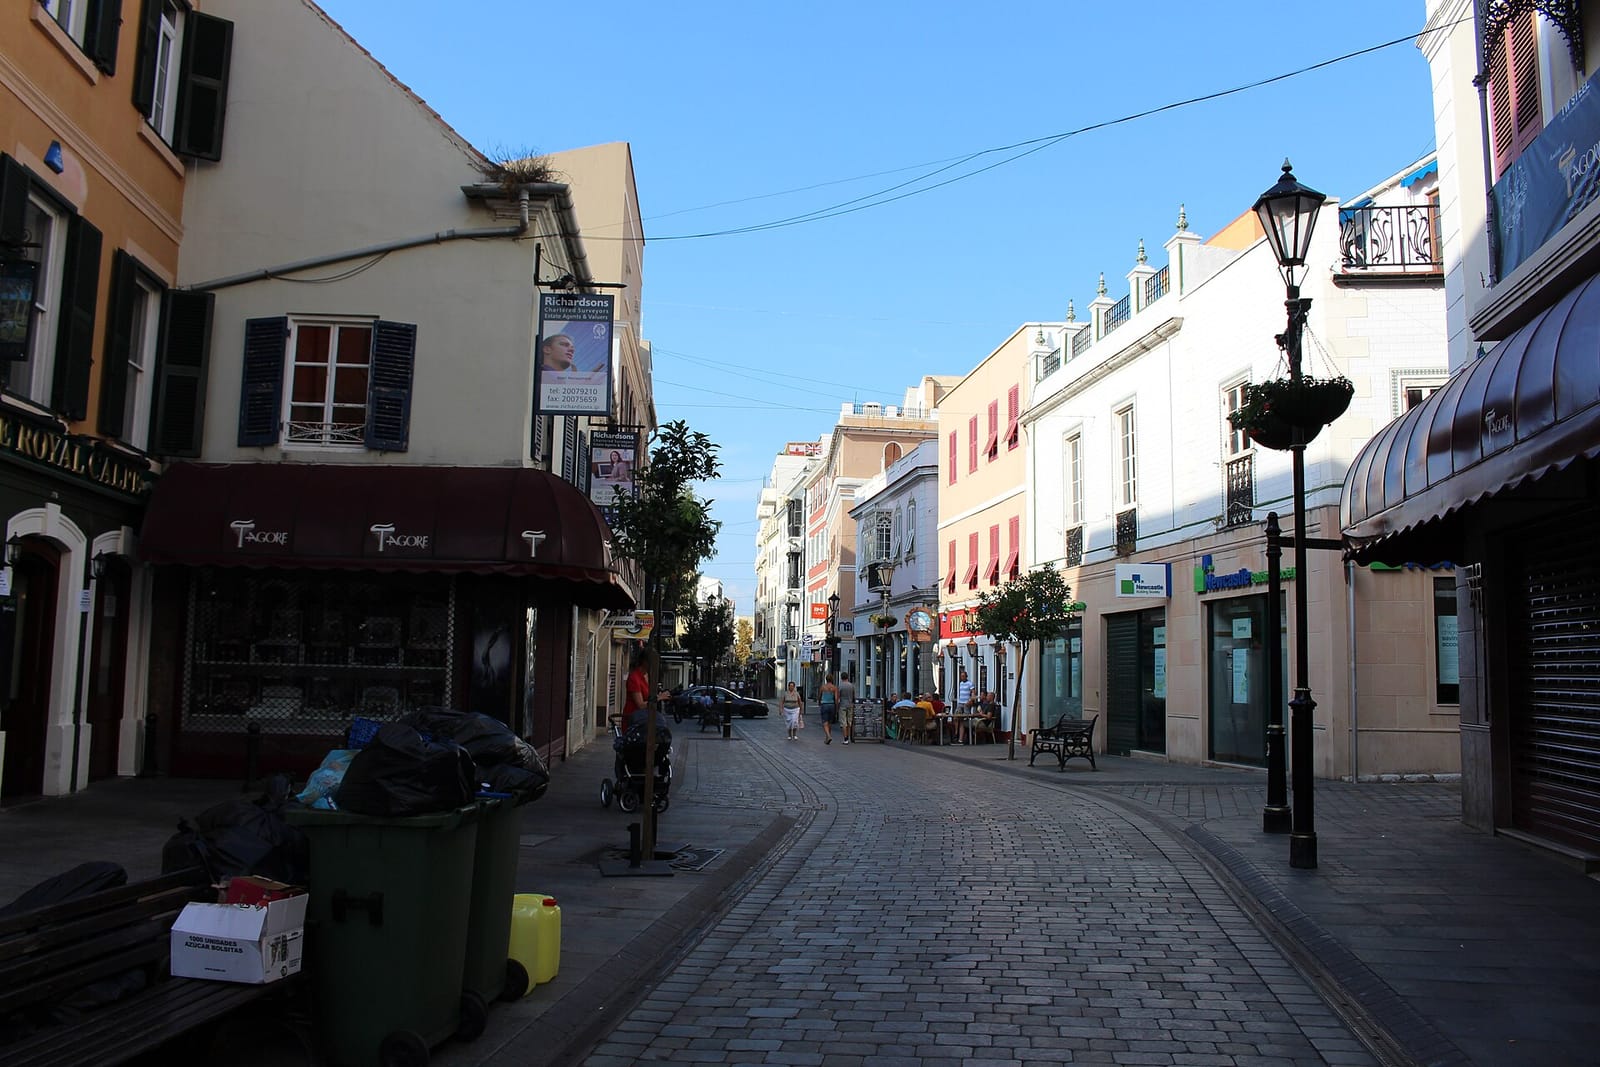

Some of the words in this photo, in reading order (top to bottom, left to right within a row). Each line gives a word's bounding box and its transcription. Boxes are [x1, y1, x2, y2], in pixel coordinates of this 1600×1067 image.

[1570, 80, 1590, 106] STEEL
[1558, 138, 1600, 198] TAGOR
[544, 296, 609, 307] Richardsons
[593, 431, 634, 440] Richardsons
[16, 423, 86, 475] ROYAL
[230, 519, 289, 548] TAGORE
[370, 522, 429, 551] TAGORE
[1206, 567, 1252, 591] Newcastle
[204, 937, 238, 947] UNIDADES
[211, 945, 244, 954] BOLSITAS
